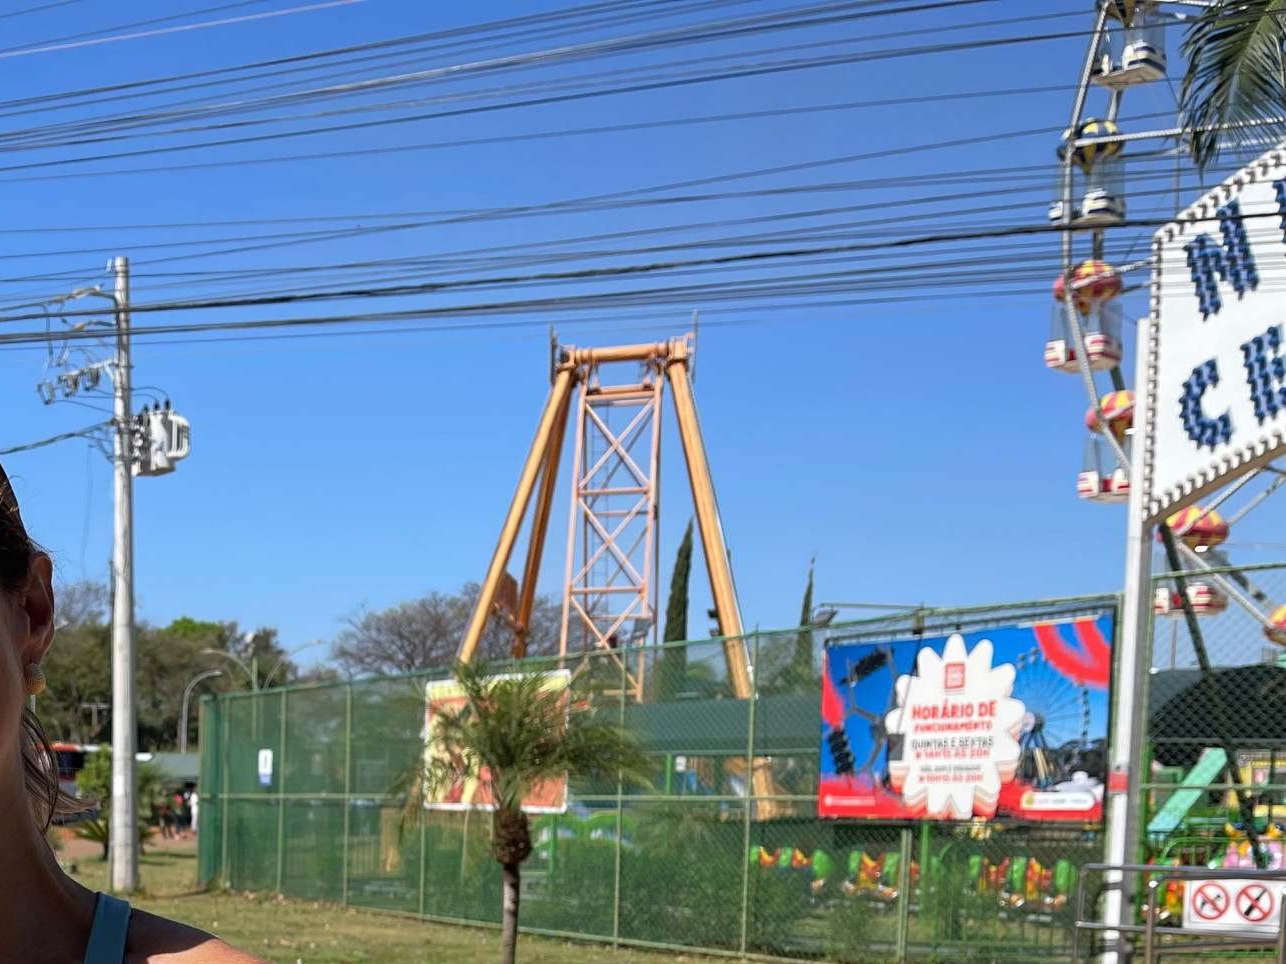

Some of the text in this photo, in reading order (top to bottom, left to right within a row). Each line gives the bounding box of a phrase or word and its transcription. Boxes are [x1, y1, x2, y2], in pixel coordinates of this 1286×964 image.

[1183, 178, 1286, 319] N
[911, 698, 997, 719] HORÁRIO DE
[912, 737, 948, 749] QUINTAS
